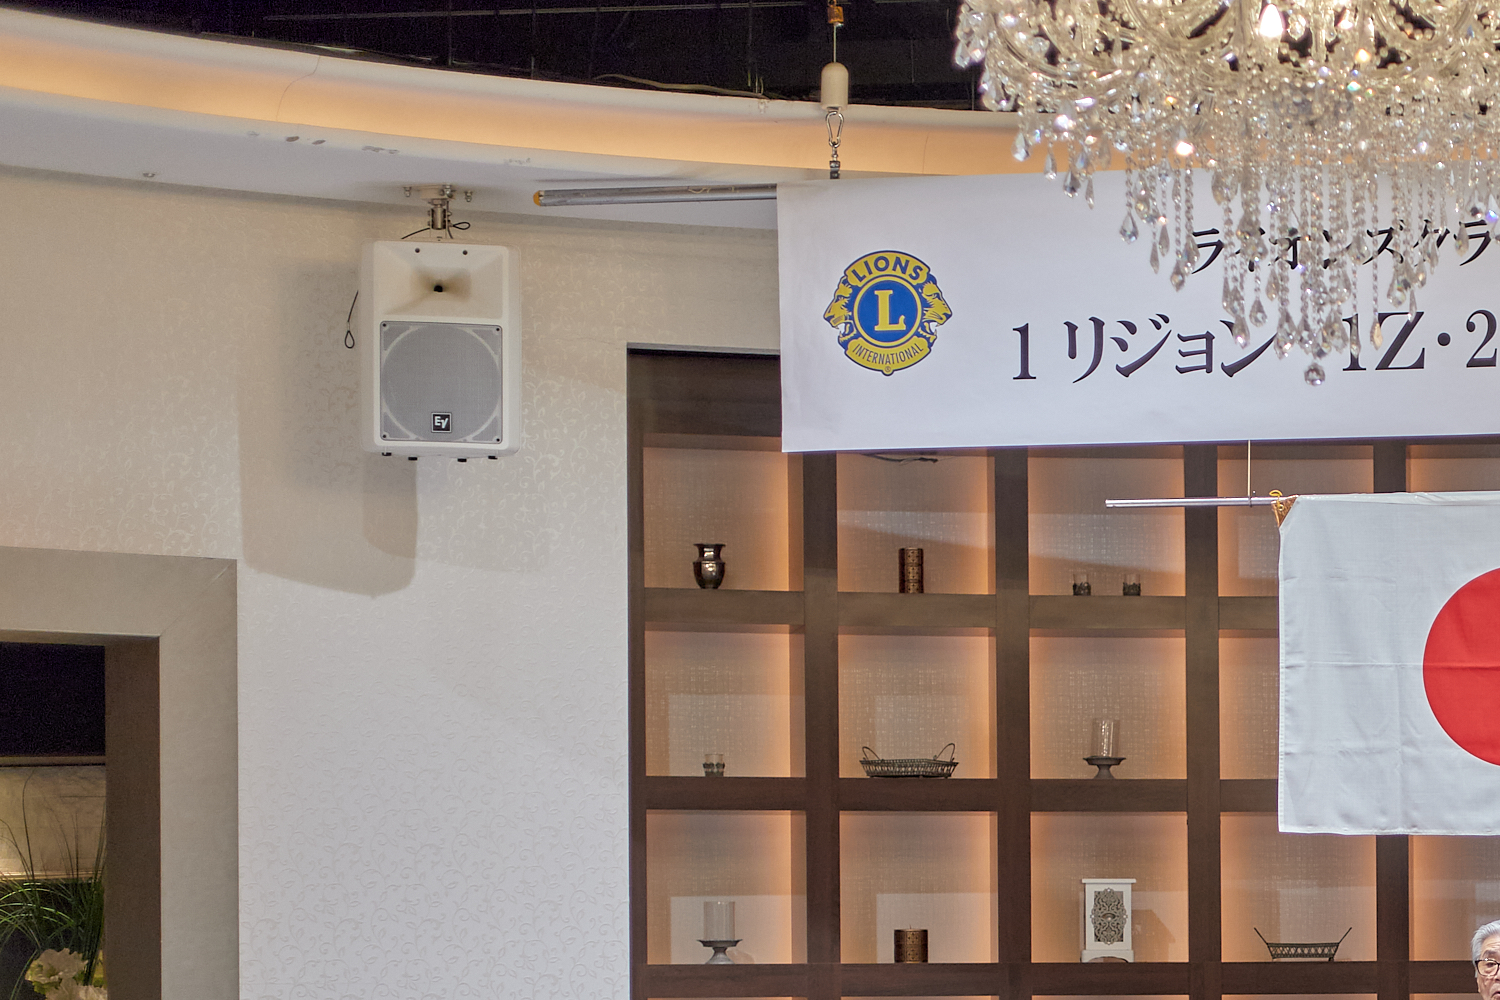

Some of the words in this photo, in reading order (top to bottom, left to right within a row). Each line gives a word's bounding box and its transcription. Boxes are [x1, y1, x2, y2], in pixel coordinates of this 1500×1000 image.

[851, 255, 924, 283] LIONS
[874, 289, 907, 331] L
[852, 342, 925, 366] INTERNATIONAL
